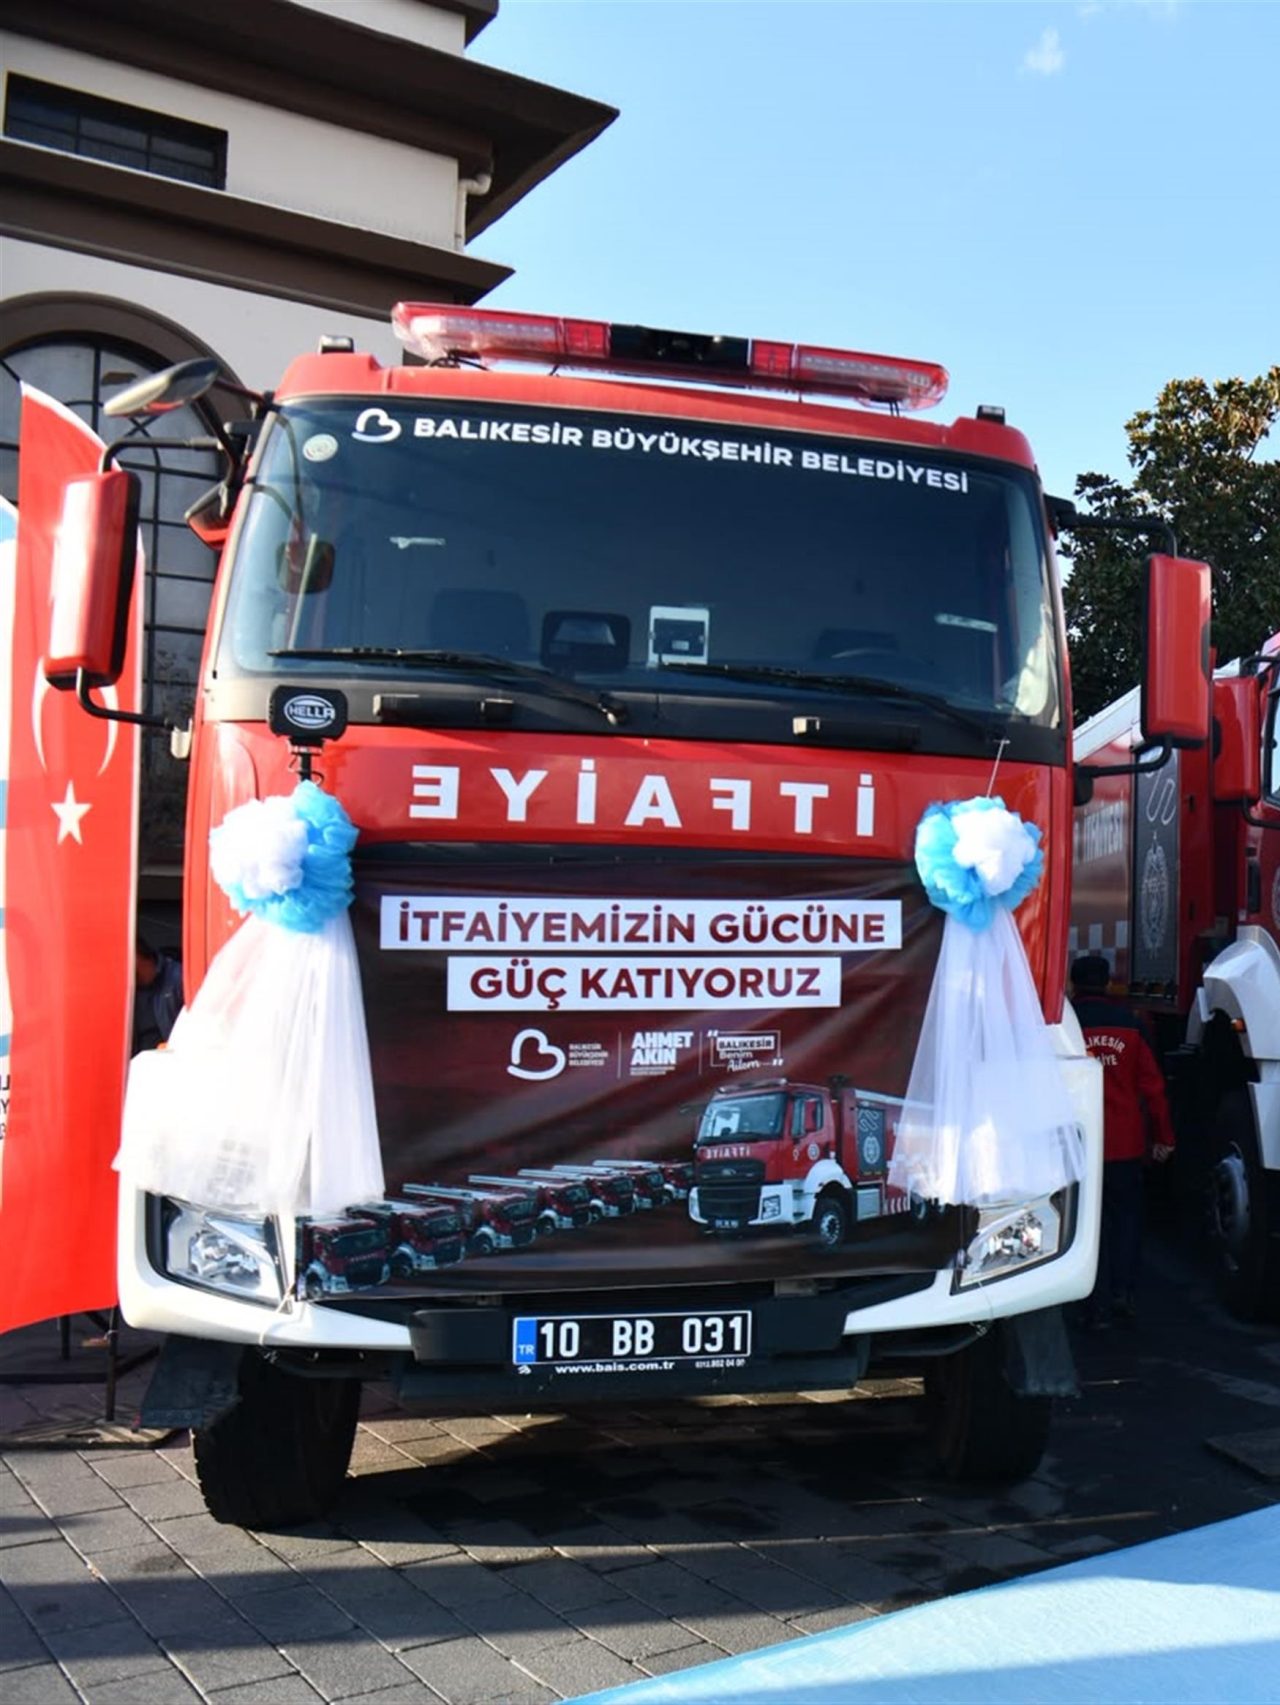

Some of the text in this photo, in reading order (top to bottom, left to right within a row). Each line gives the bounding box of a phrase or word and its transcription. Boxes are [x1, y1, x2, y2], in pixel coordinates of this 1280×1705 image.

[413, 418, 969, 493] BALIKESİR BÜYÜKŞEHİR BELEDİYESİ
[288, 704, 336, 720] HELLA
[399, 901, 885, 943] İTFAİYEMİZİN GÜCÜNE
[470, 959, 821, 1009] GÜÇ KATIYORUZ
[631, 1031, 694, 1048] AHMET
[630, 1048, 677, 1065] AKIN
[518, 1344, 535, 1355] TR
[540, 1316, 743, 1358] 10 BB 031
